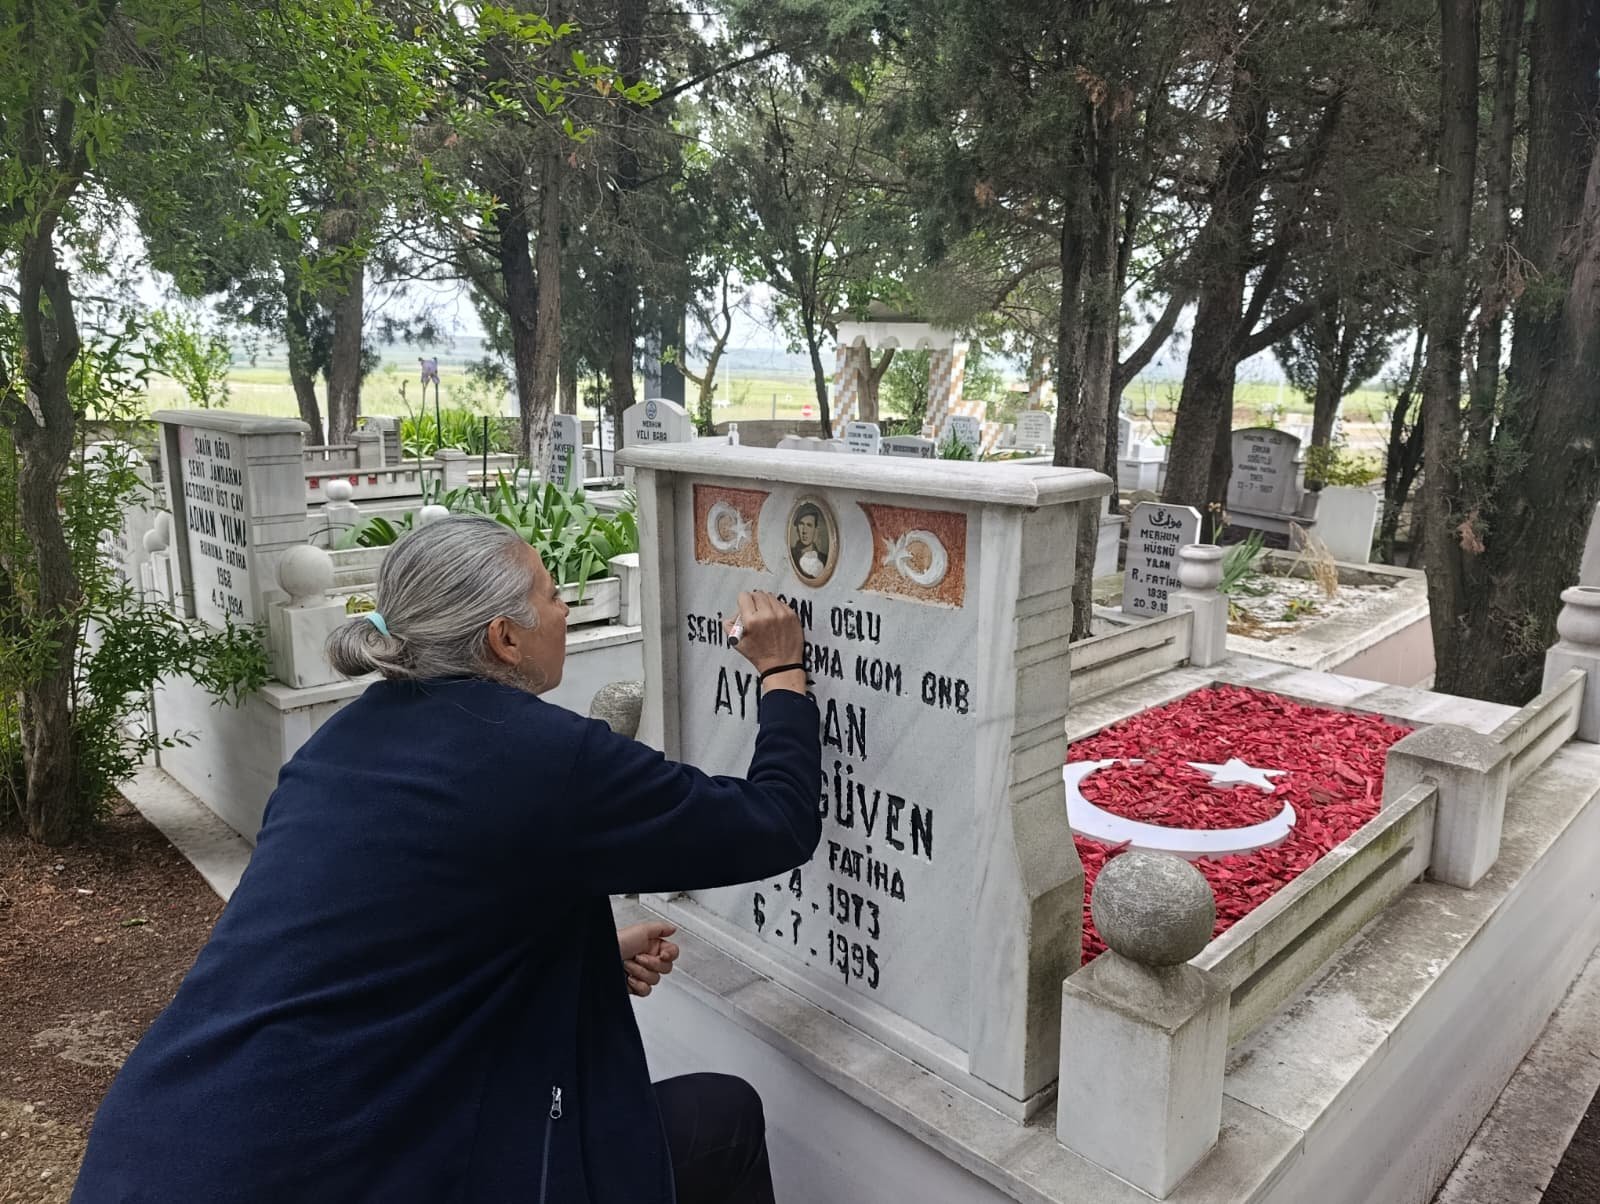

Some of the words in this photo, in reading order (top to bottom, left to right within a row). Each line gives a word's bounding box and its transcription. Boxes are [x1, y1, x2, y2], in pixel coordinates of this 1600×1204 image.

[214, 437, 230, 460] OĞLU
[188, 455, 205, 480] ŞEHİT
[185, 481, 214, 504] ASTSUBAY
[216, 484, 228, 508] ÜST
[189, 505, 216, 538] ADNAN
[1140, 528, 1180, 543] MERHUM
[200, 540, 224, 562] RUHUNA
[226, 547, 247, 570] FATİHA
[1144, 541, 1176, 557] HÜSNÜ
[828, 839, 905, 902] FATİHA
